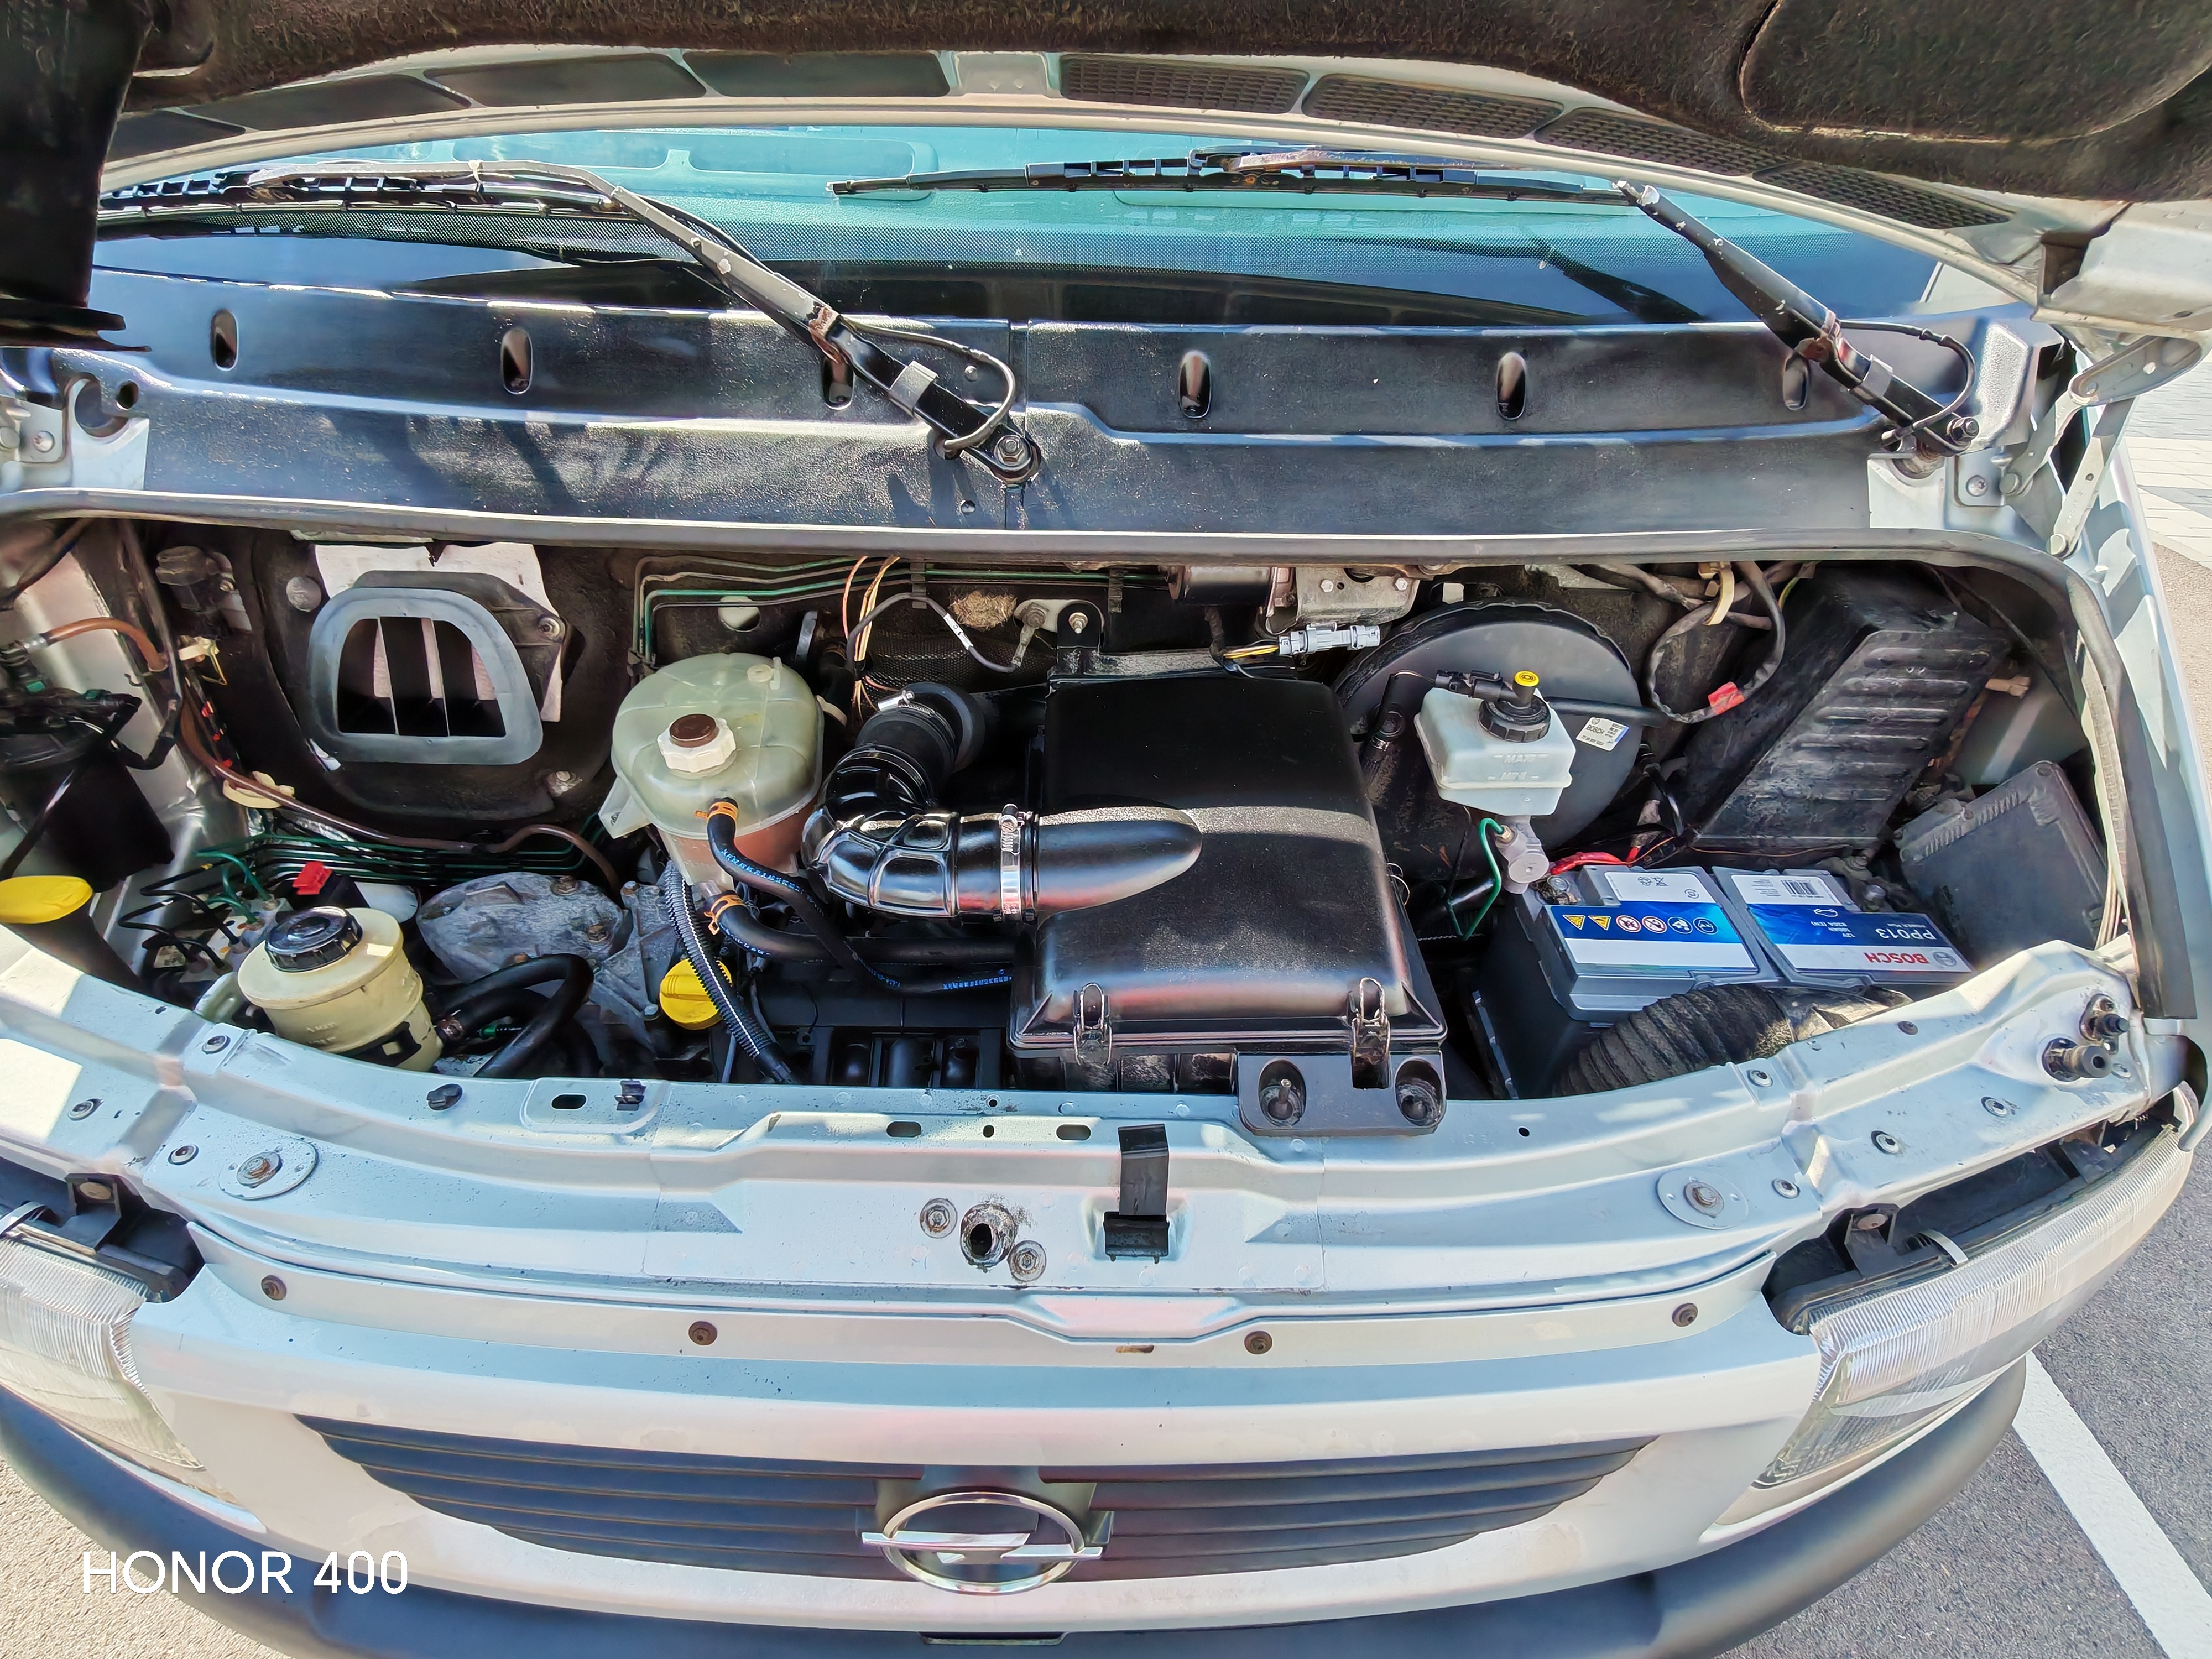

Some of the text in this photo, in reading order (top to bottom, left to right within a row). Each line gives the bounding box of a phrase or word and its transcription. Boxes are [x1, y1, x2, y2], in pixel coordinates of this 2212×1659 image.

[1585, 724, 1605, 735] BOSCH
[1875, 928, 1937, 940] PP013
[1863, 952, 1929, 964] BOSCH
